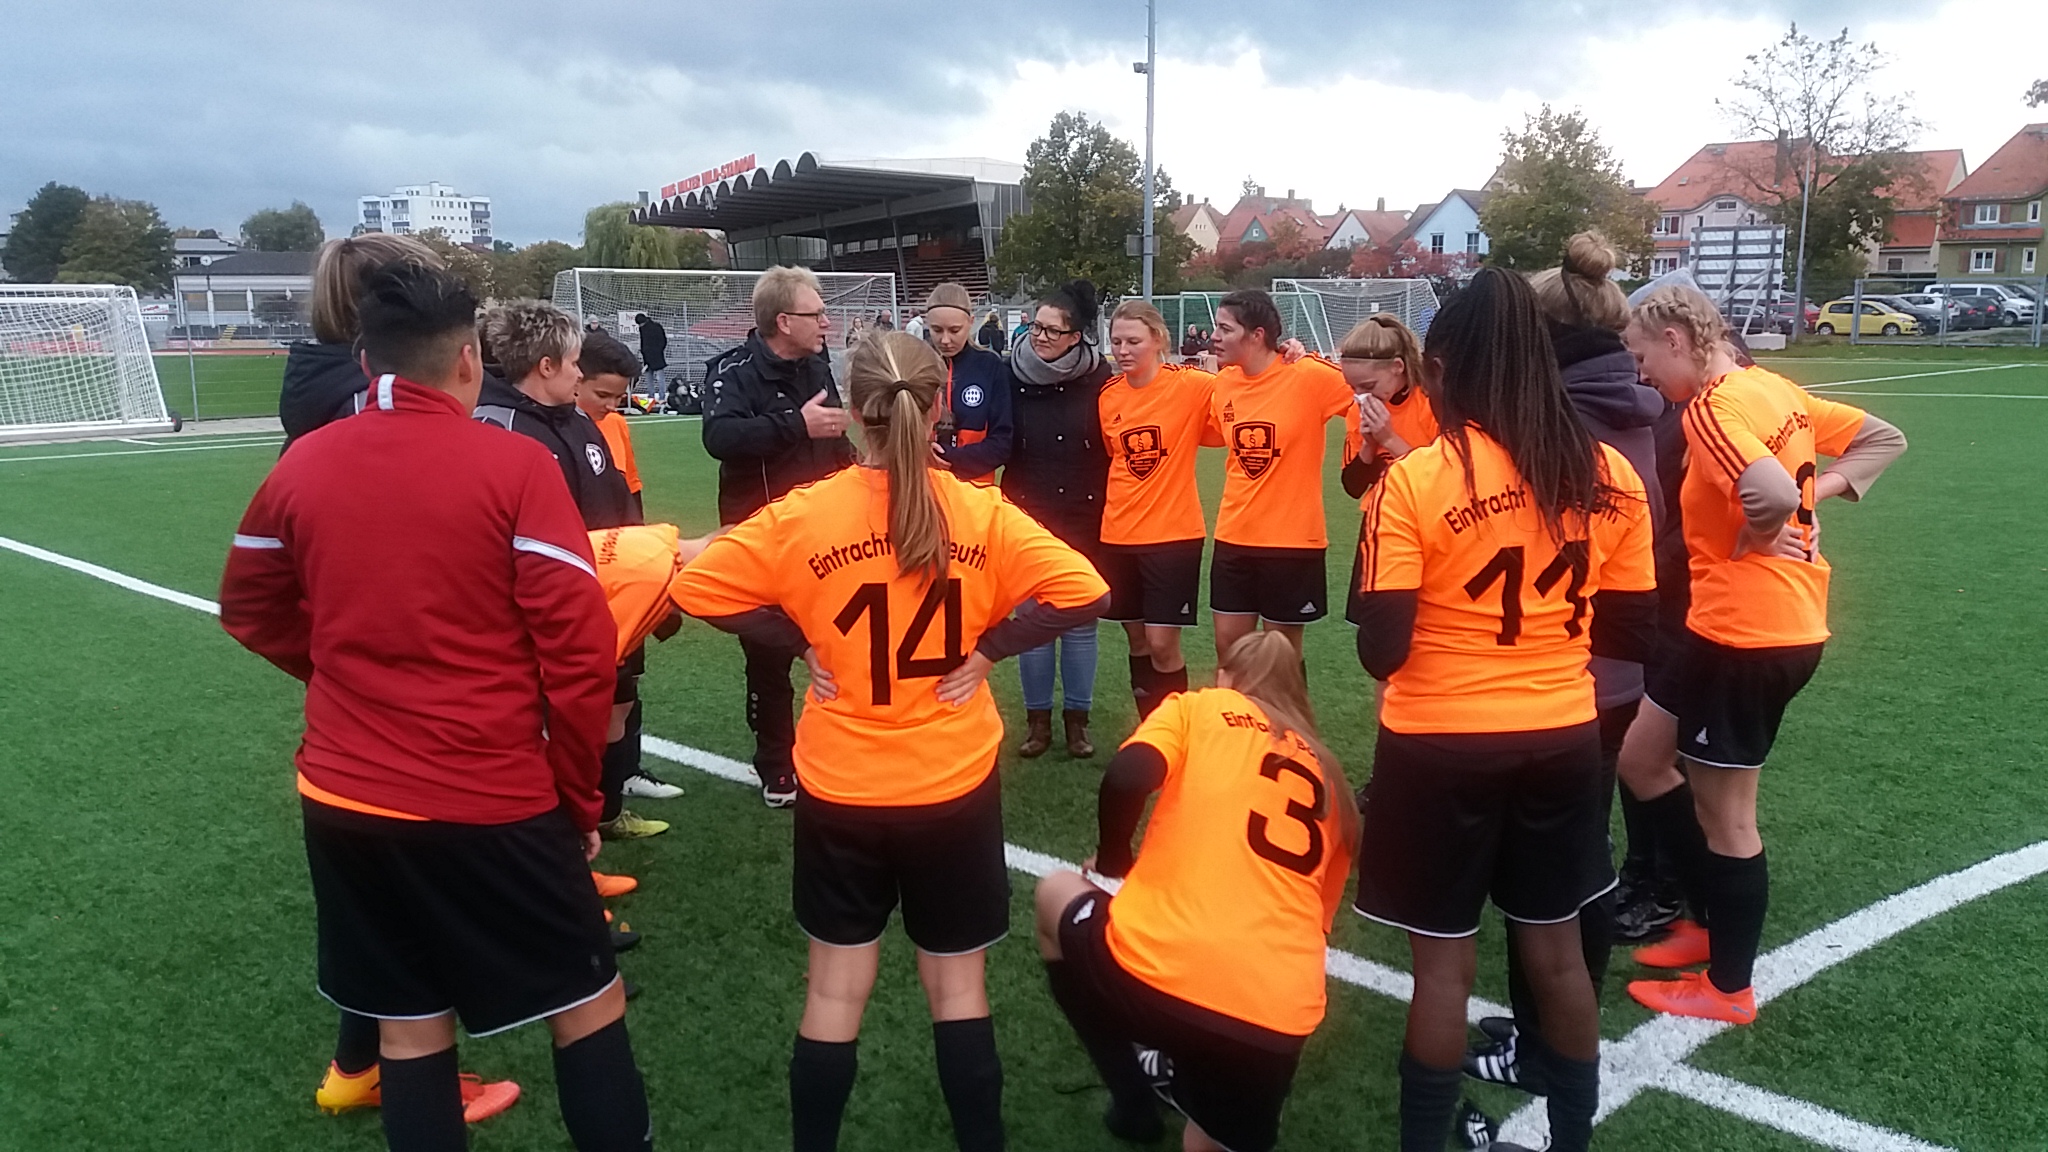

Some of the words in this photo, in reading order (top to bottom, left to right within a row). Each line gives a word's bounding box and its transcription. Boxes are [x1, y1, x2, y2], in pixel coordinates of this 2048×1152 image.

[808, 532, 891, 580] Eintracht
[949, 541, 987, 572] euth
[1443, 484, 1527, 535] Eintracht
[832, 577, 969, 706] 14
[1463, 539, 1591, 647] 11
[1247, 751, 1326, 877] 3
